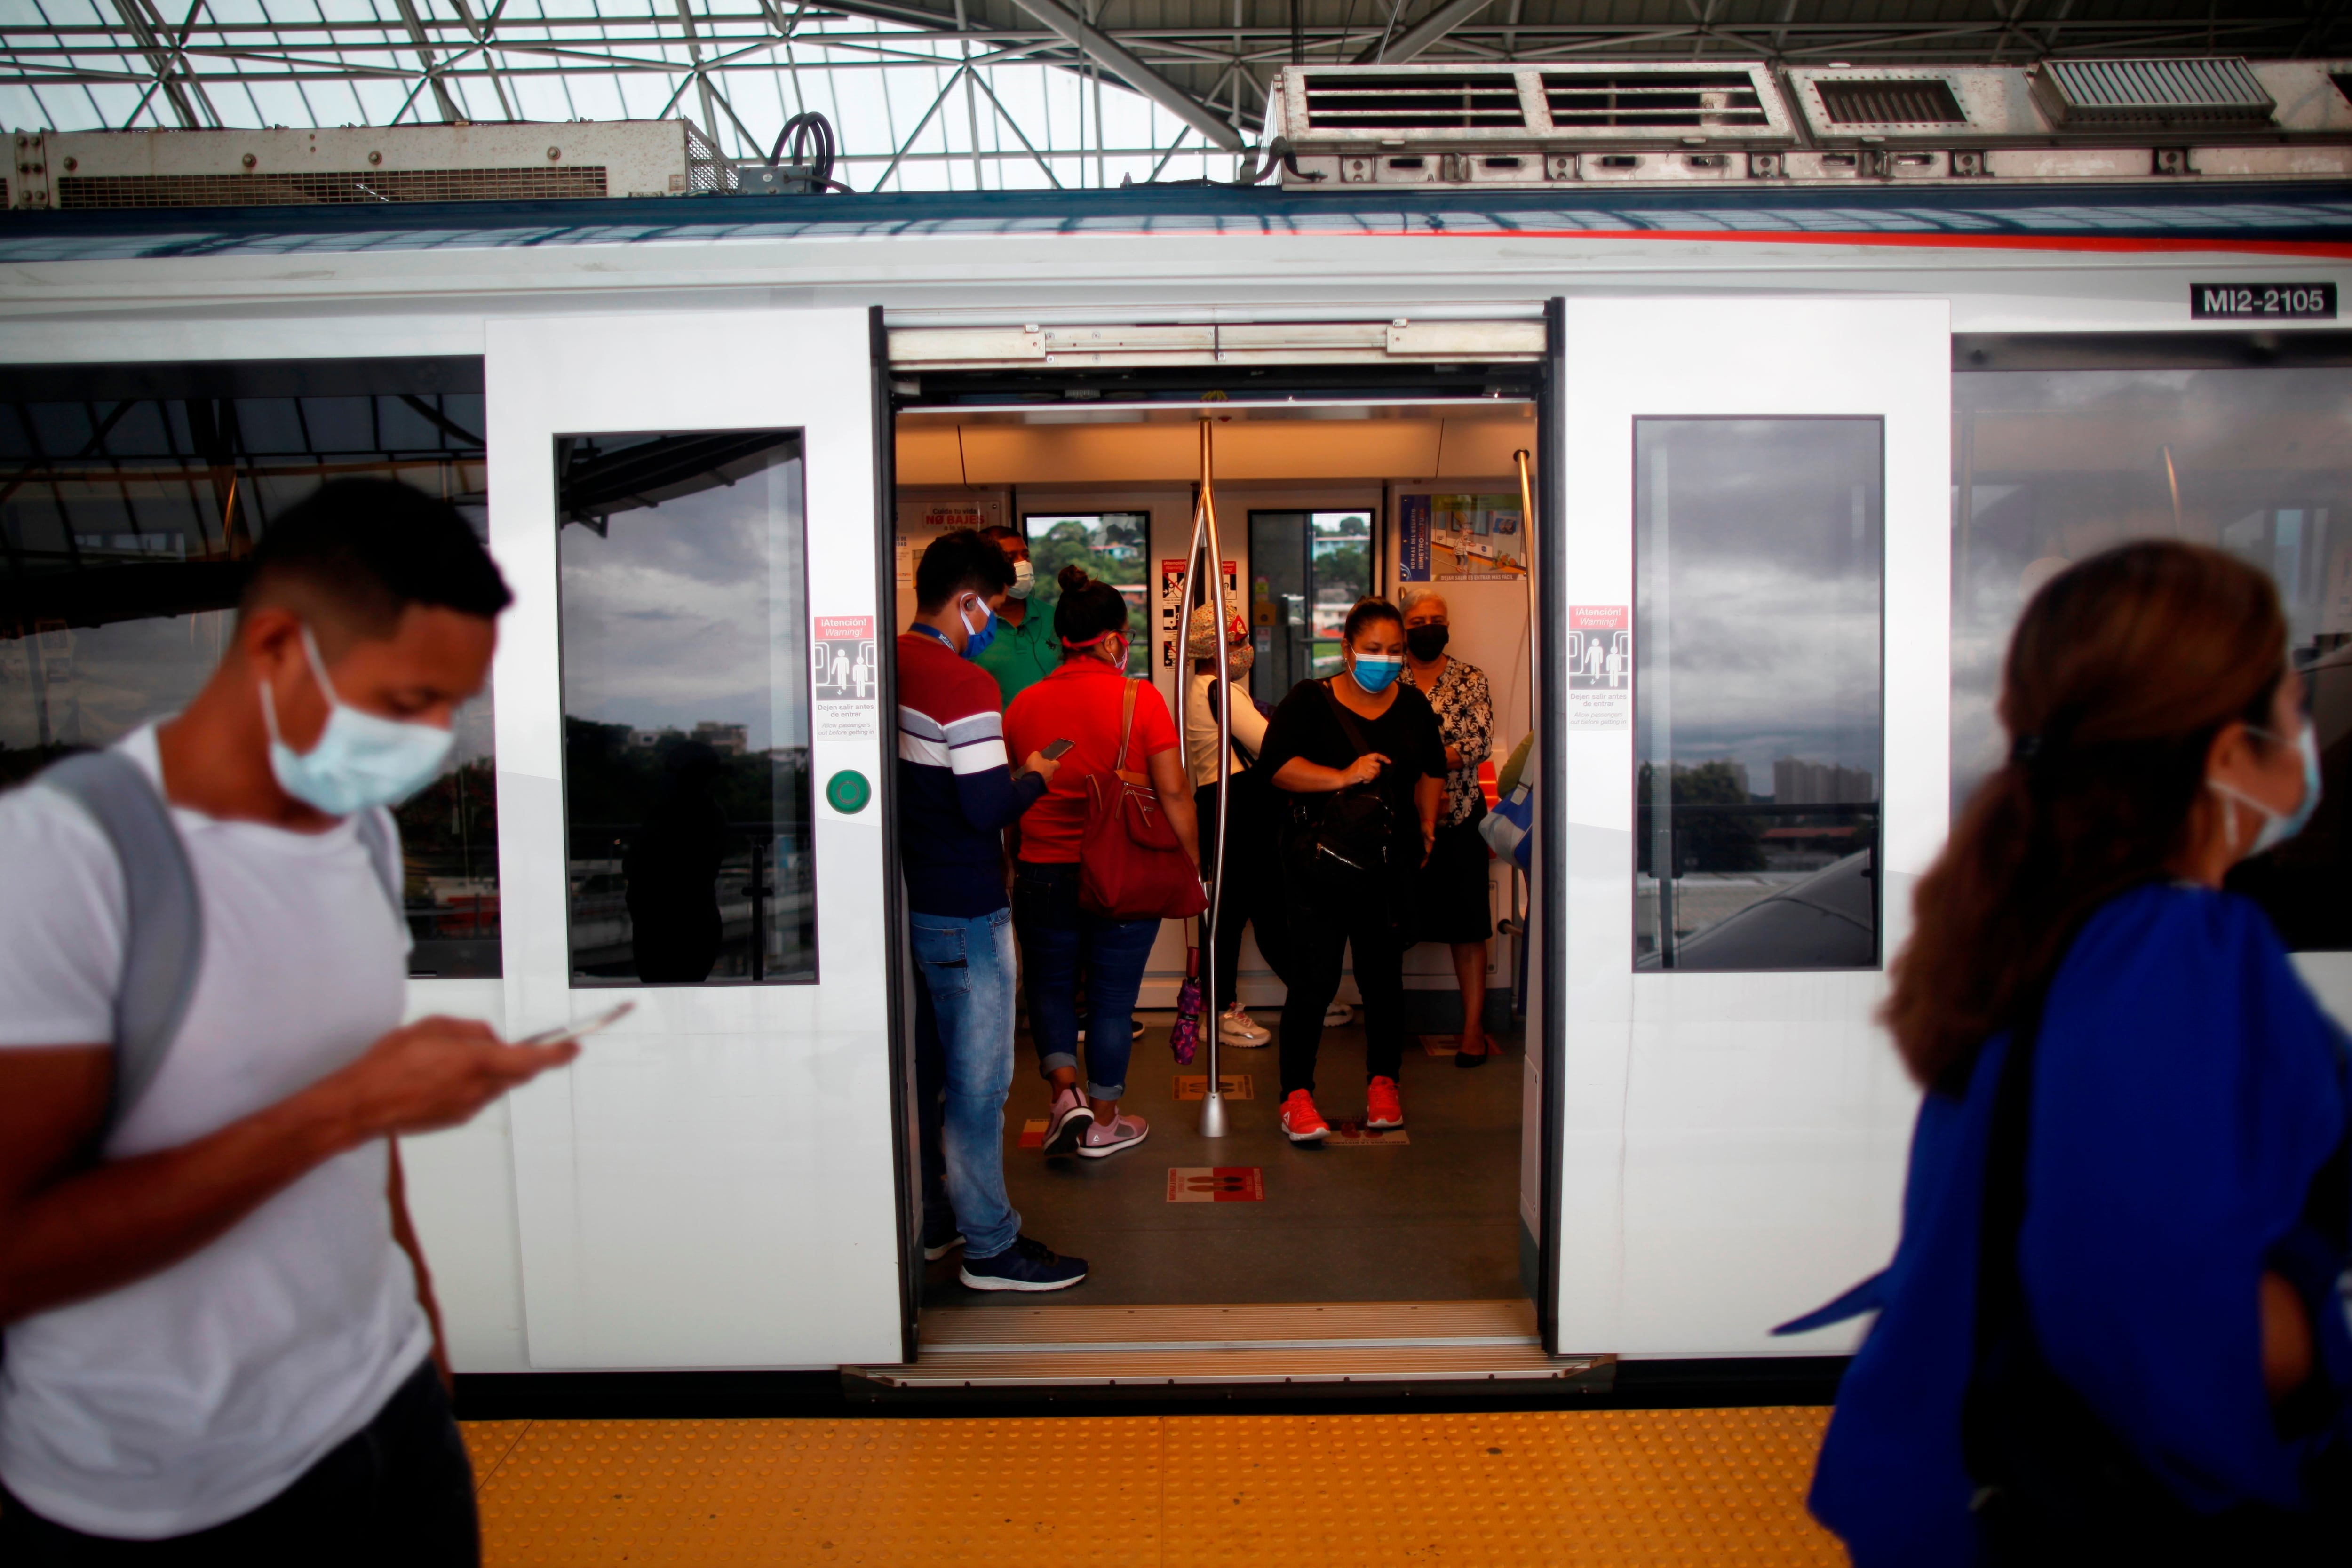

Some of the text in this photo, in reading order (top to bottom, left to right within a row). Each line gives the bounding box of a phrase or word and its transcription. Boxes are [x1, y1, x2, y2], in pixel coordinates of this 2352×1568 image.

[2204, 290, 2324, 312] MI2-2105
[947, 515, 985, 525] BAJES
[821, 618, 866, 627] ¡Atención!
[1580, 618, 1617, 627] Warning!
[826, 628, 863, 637] Warning!
